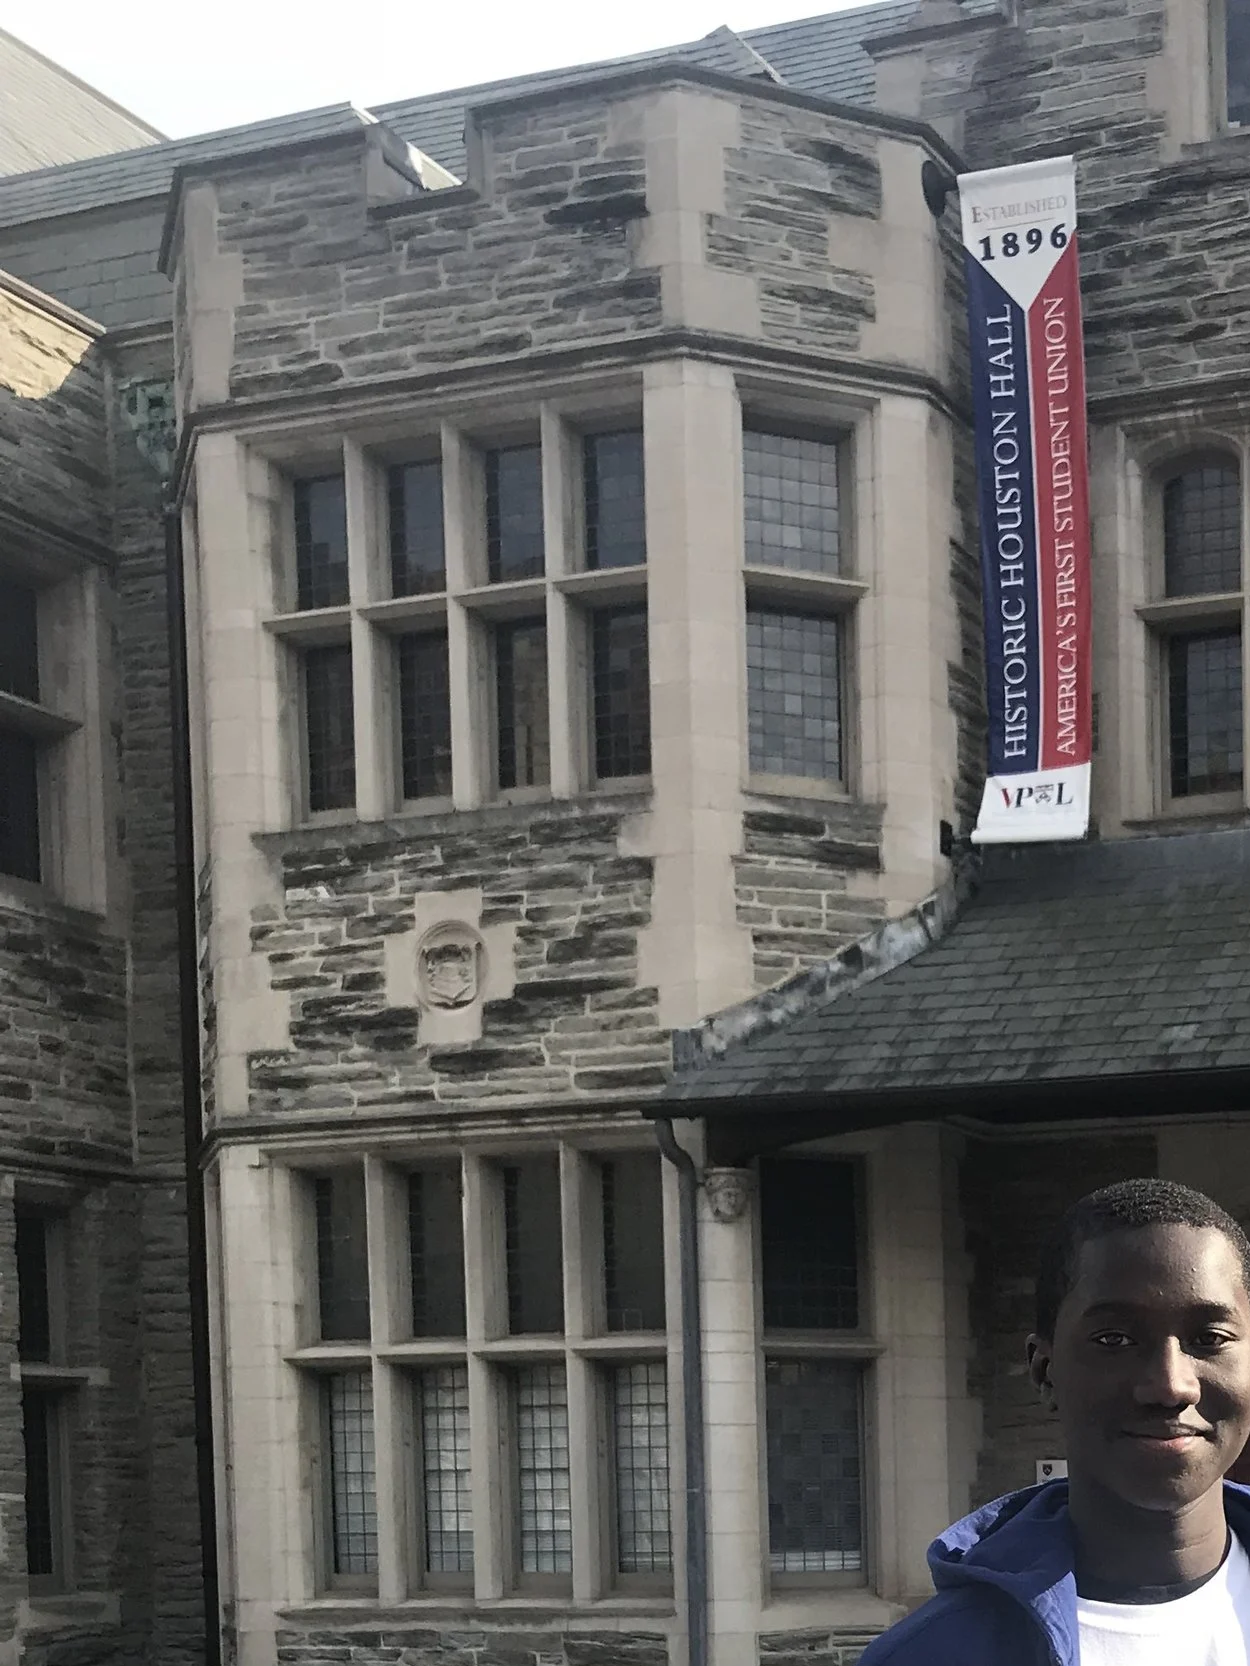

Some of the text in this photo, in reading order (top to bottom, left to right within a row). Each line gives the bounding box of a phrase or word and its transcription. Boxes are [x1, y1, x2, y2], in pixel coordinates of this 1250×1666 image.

[979, 223, 1068, 262] 1896
[986, 303, 1028, 759] HISTORIC HOUSTON HALL
[1043, 297, 1078, 756] AMERICA'S FIRST STUDENT UNION
